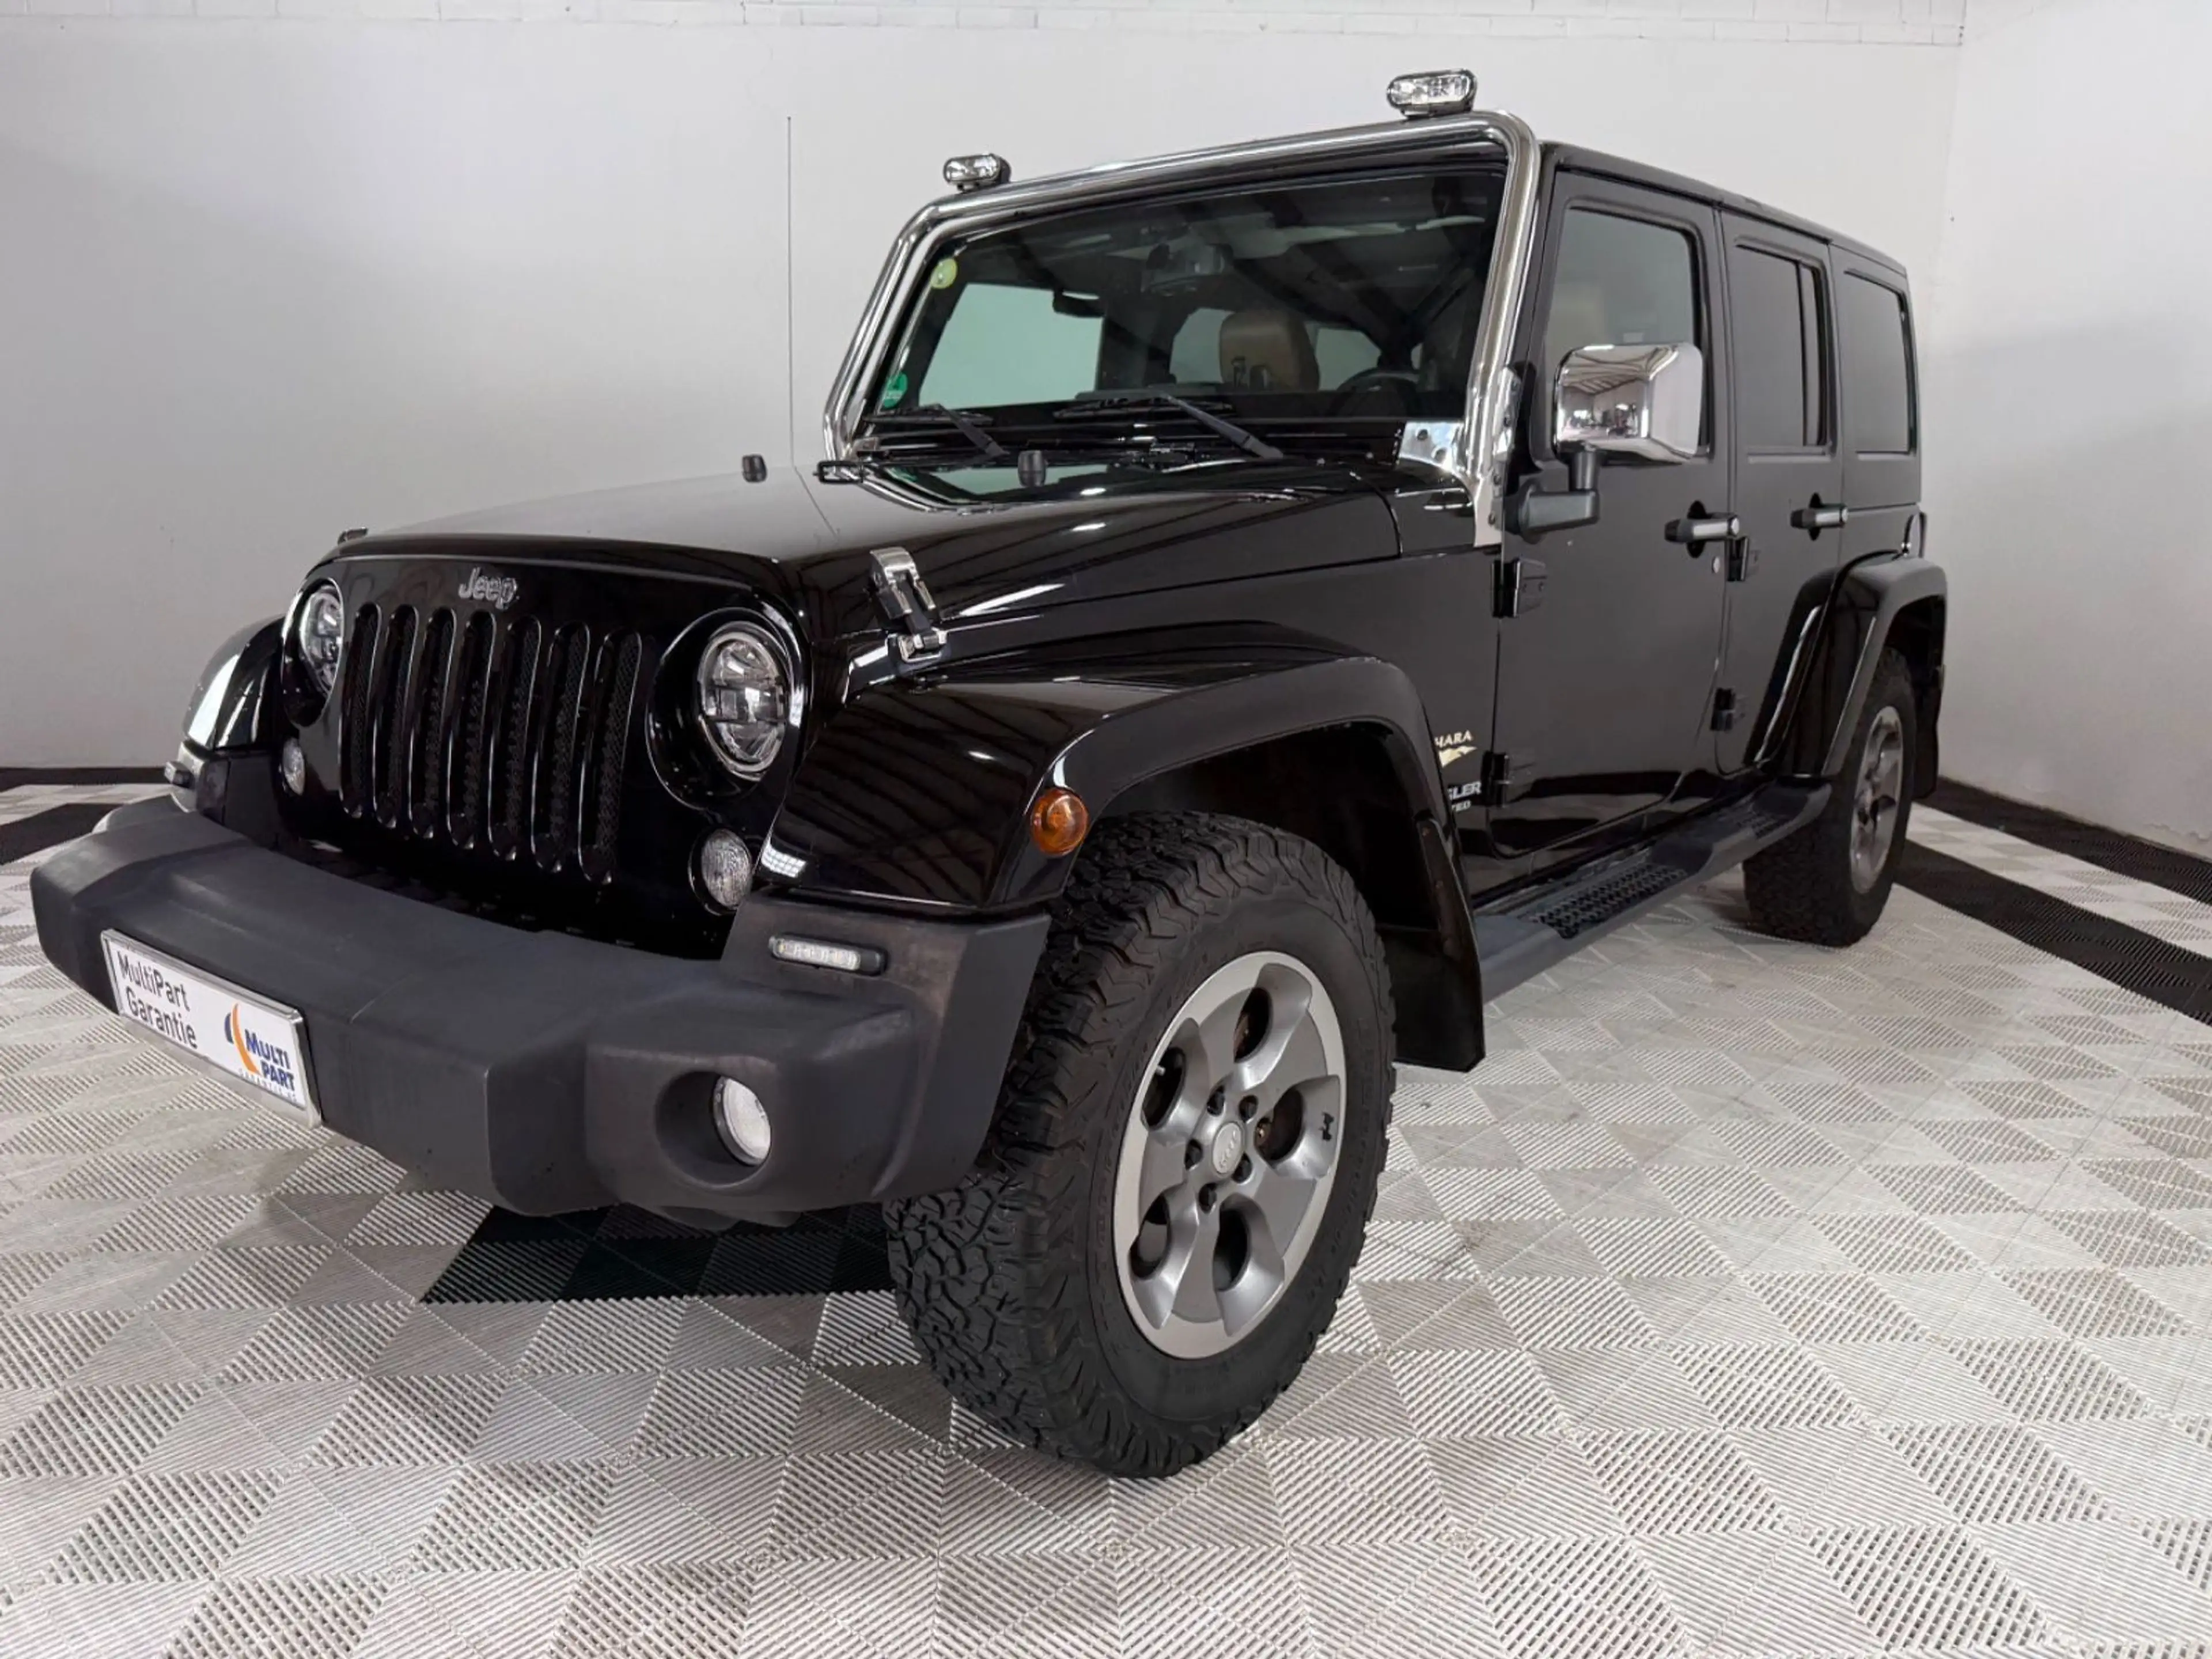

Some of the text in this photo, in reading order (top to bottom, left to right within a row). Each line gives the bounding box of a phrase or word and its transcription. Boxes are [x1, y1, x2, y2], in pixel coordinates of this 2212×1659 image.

[458, 566, 518, 610] Jeep
[117, 950, 191, 1012] MultiPart
[126, 985, 198, 1050] Garantie
[244, 1028, 290, 1070] MULTI
[260, 1059, 295, 1092] PART
